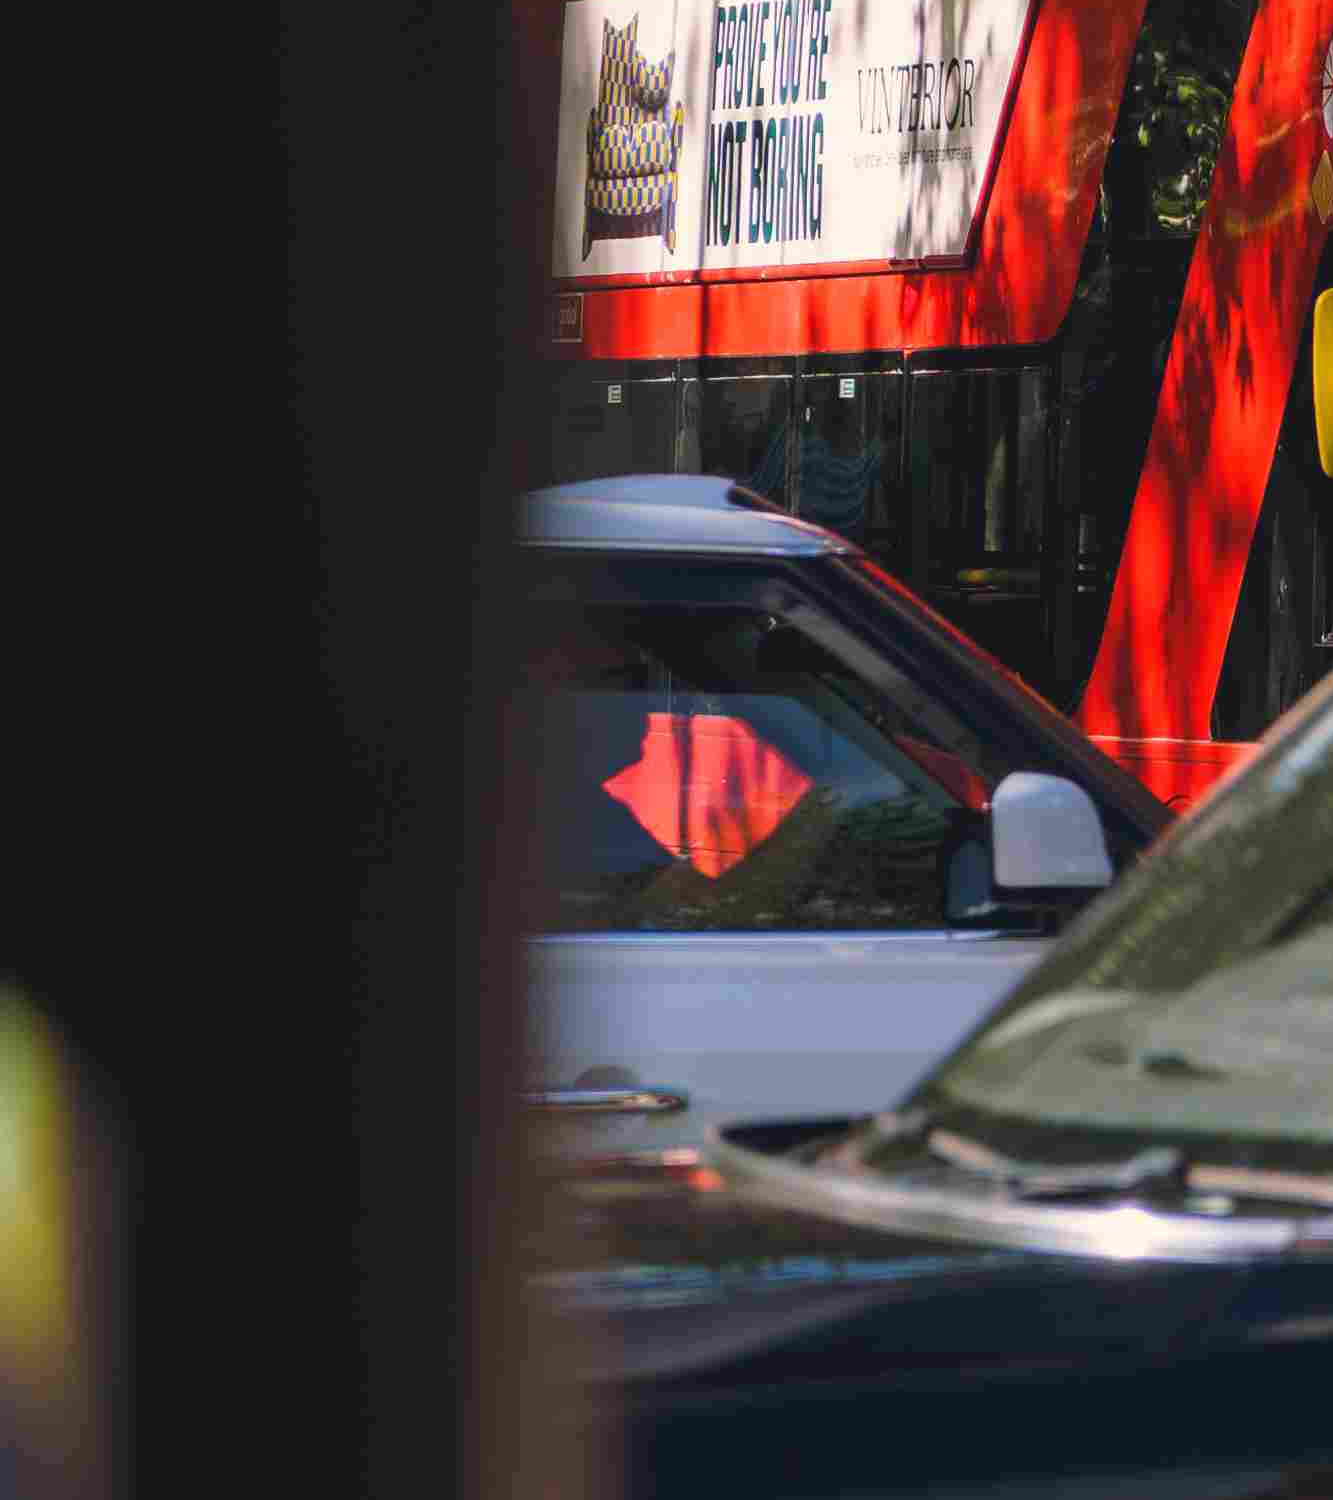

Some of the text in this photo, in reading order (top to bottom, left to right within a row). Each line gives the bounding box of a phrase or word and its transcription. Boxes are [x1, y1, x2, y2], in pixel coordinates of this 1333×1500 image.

[712, 1, 769, 111] PROVE
[857, 56, 976, 135] VINTERIOR
[706, 111, 825, 247] NOT BORING
